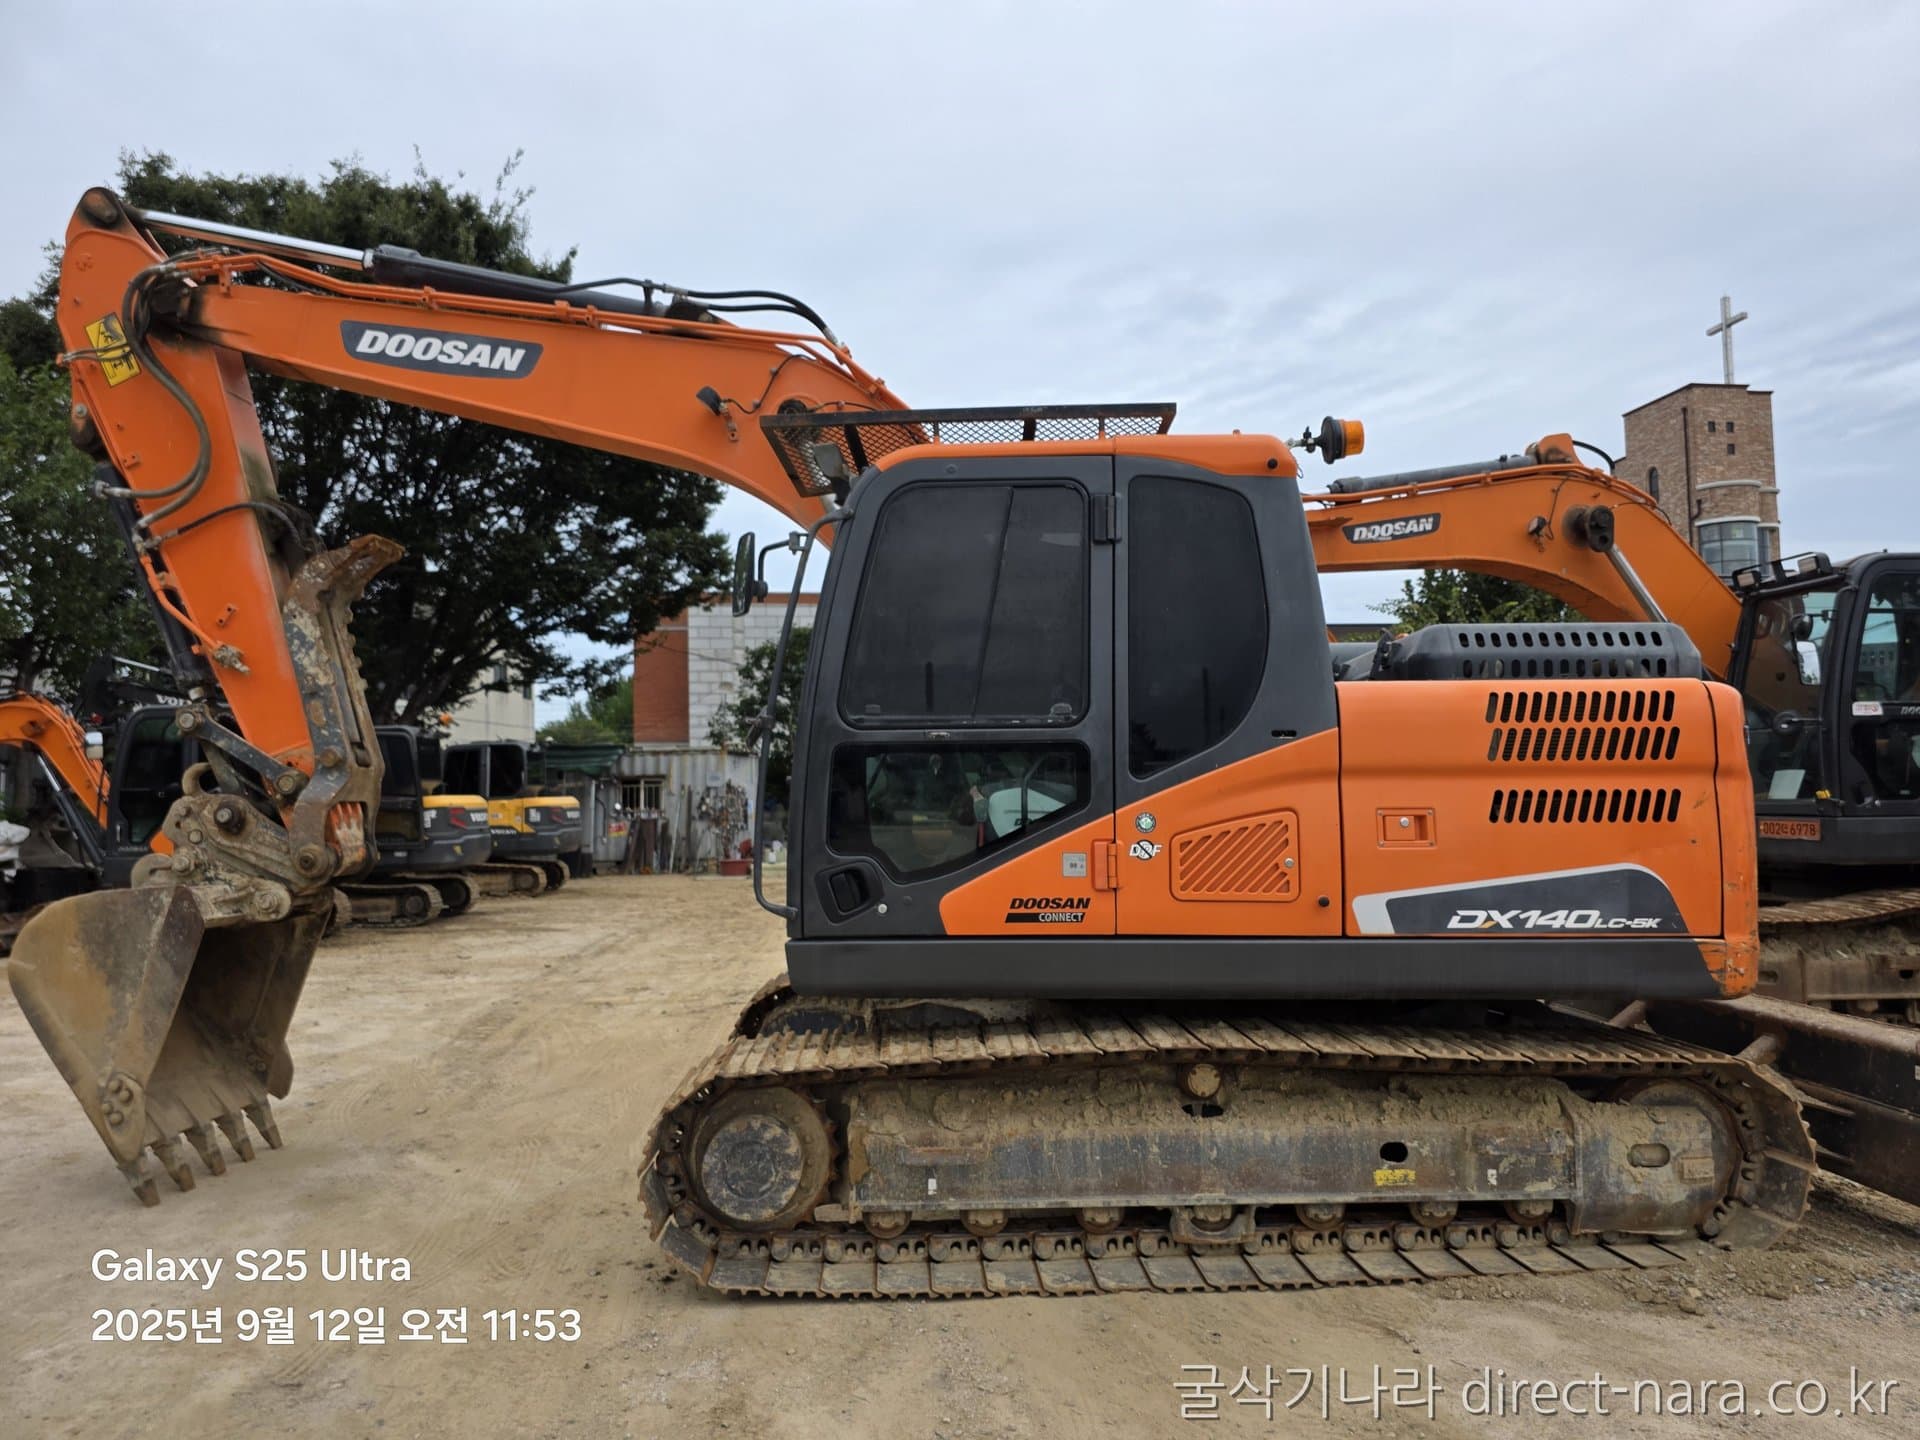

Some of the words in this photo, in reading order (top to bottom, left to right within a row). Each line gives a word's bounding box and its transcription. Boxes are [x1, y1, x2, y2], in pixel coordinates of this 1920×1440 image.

[355, 329, 526, 371] DOOSAN
[1352, 516, 1434, 541] DOOSAN
[1009, 897, 1091, 909] DOOSAN
[1038, 912, 1083, 922] CONNECT
